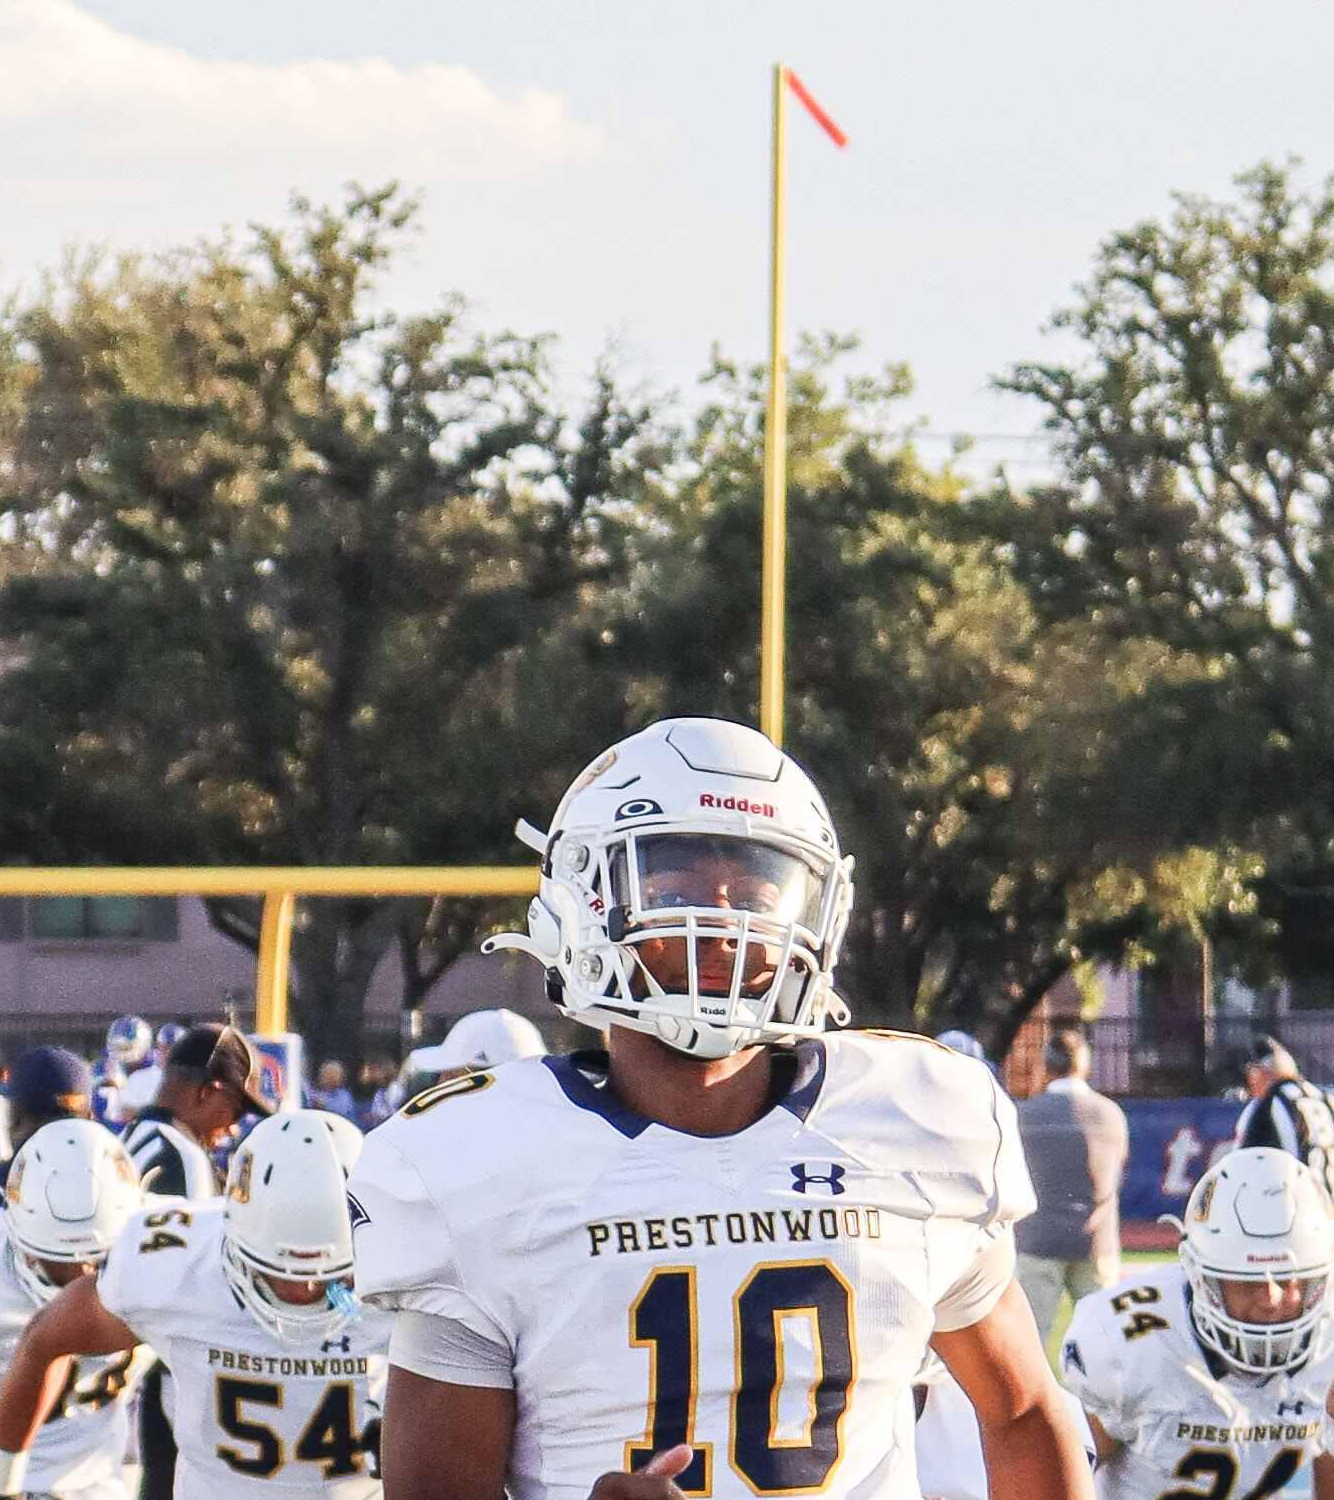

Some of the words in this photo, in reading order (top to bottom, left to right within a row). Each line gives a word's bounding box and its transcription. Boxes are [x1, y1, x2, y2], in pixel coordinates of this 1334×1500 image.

[699, 793, 774, 818] Riddell
[587, 1206, 882, 1258] PRESTONWOOD
[1110, 1284, 1170, 1342] 24
[207, 1348, 368, 1377] PRESTONWOOD
[624, 1257, 855, 1498] 10
[215, 1375, 366, 1480] 54
